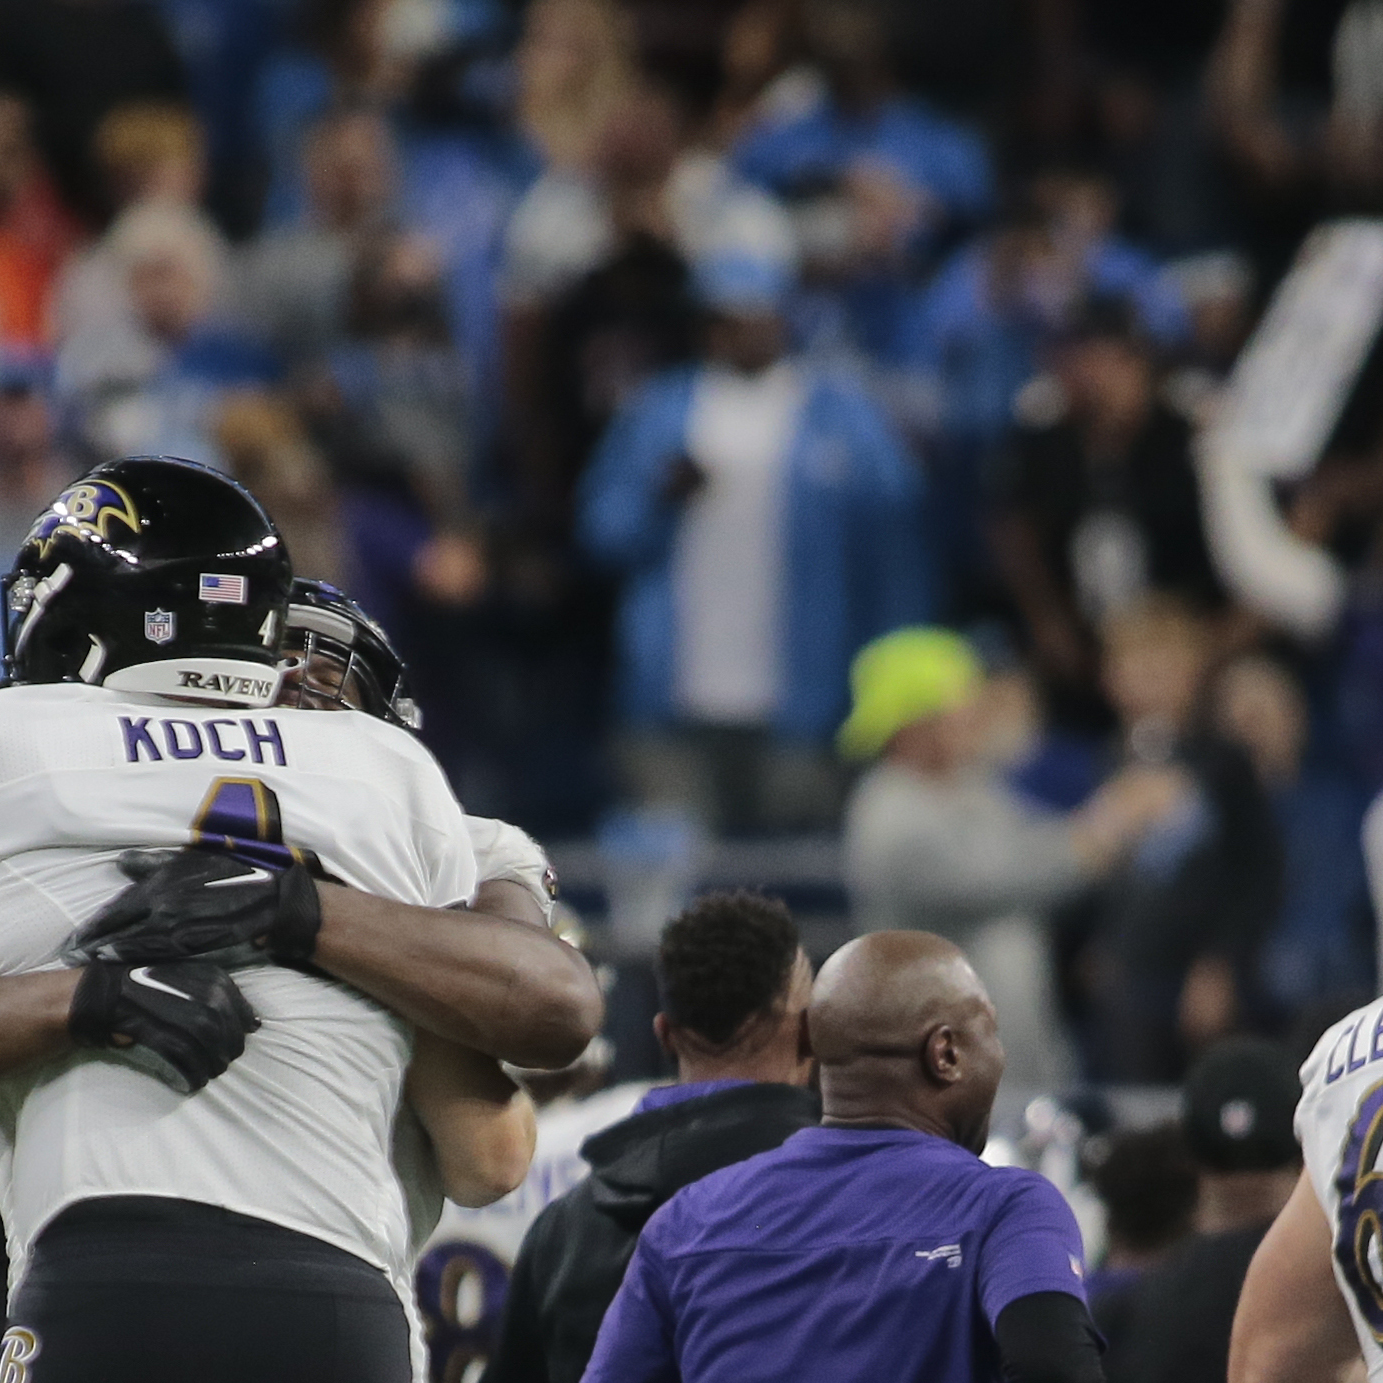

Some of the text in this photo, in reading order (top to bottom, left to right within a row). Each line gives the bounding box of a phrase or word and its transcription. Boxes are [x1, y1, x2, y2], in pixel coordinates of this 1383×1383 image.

[148, 623, 170, 638] NFL
[258, 610, 275, 646] 4
[176, 669, 273, 699] RAVENS
[117, 715, 287, 767] KOCH
